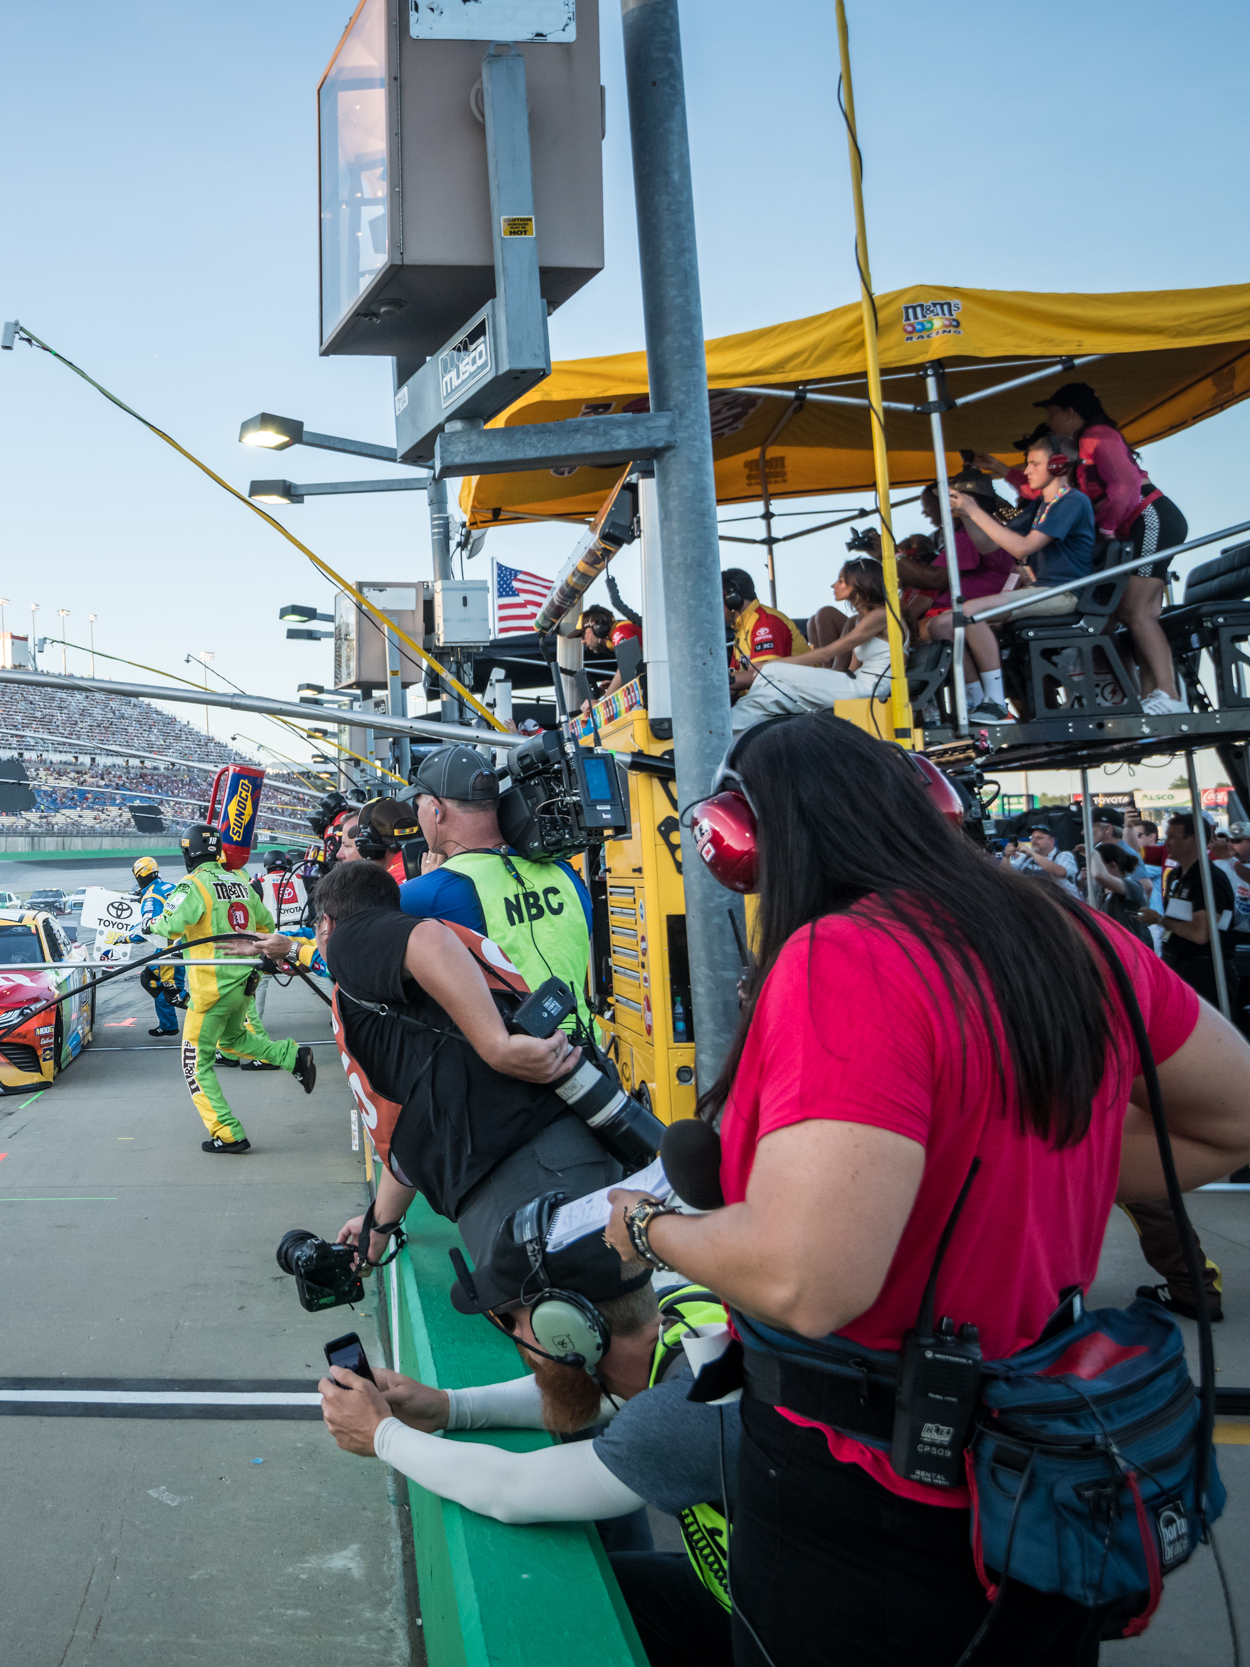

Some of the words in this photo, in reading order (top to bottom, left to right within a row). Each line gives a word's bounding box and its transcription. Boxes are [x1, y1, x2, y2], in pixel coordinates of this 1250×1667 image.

[905, 330, 961, 341] RACING
[1092, 795, 1130, 806] TOYOTA
[230, 779, 252, 841] SUNOCO
[503, 887, 564, 926] NBC
[934, 1353, 973, 1364] MOTOROLA
[915, 1469, 946, 1480] RENTAL
